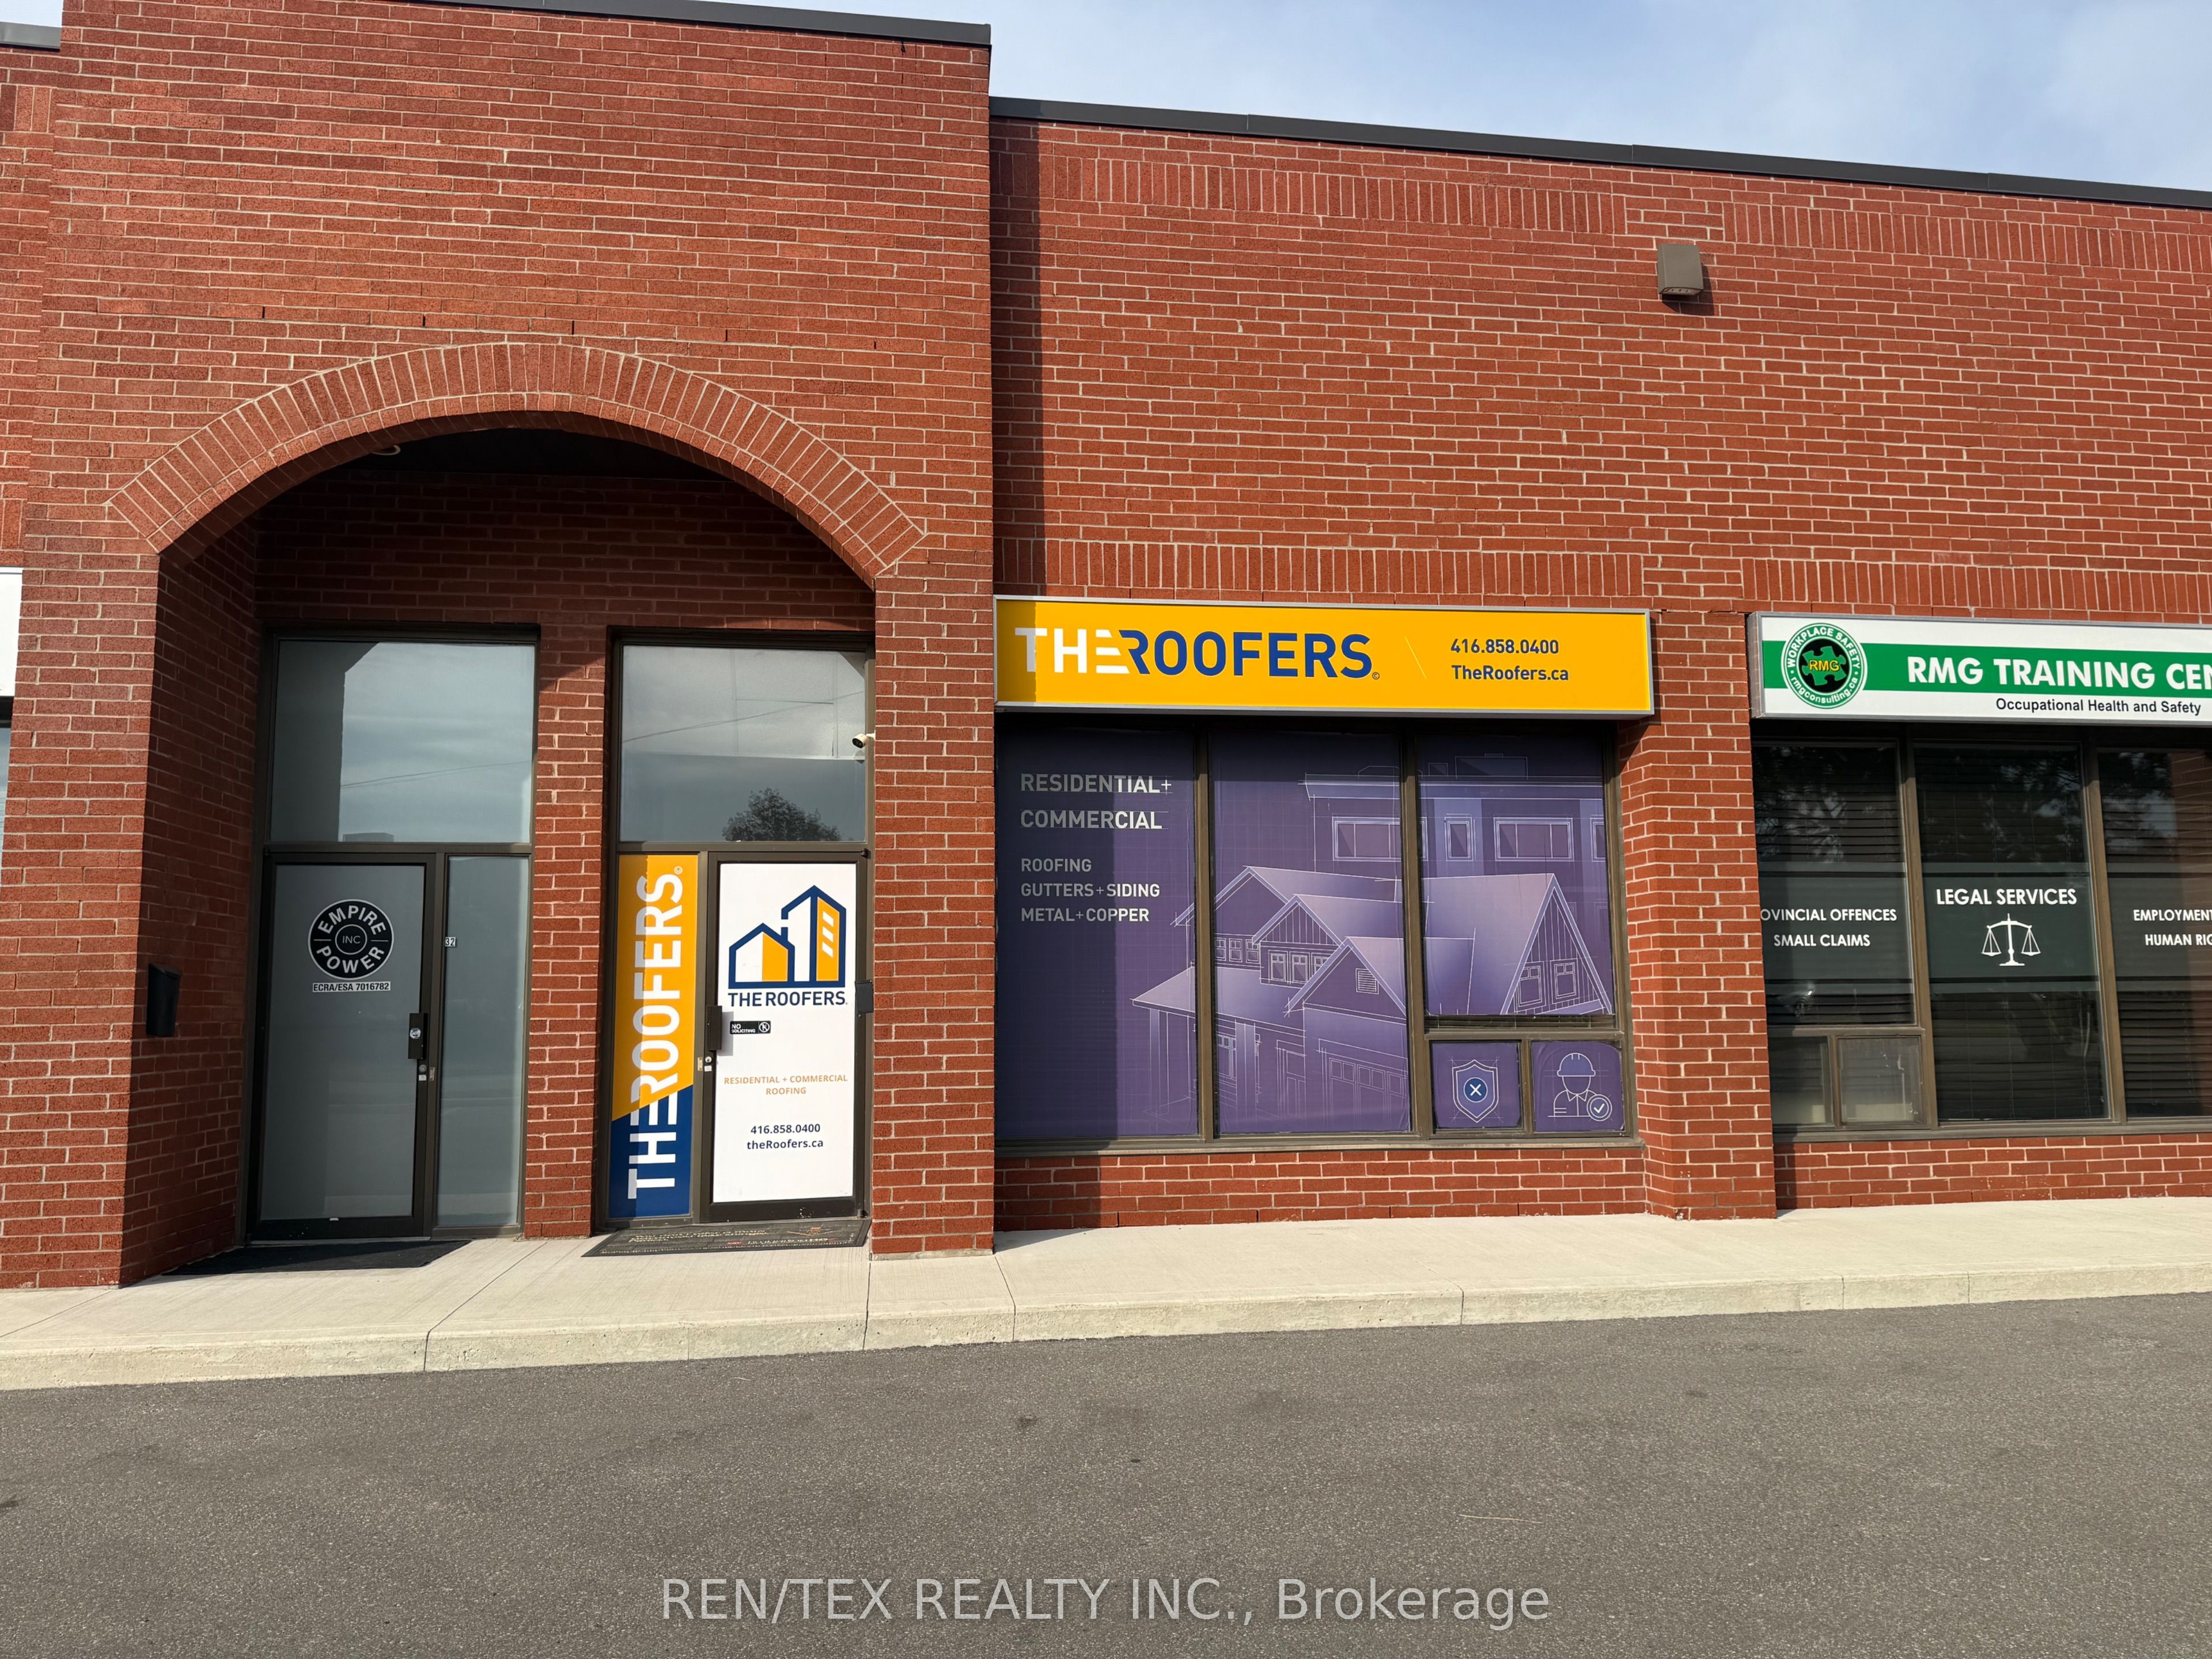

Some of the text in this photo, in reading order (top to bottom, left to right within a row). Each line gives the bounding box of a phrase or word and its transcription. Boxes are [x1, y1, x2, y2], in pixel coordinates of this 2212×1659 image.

[1450, 639, 1559, 654] 416.858.0400
[1787, 627, 1861, 669] WORKPLACE SAFETY
[1452, 664, 1569, 681] TheRoofers.ca
[1809, 660, 1840, 672] RMG
[1907, 656, 1983, 685] RMG
[1993, 658, 2156, 689] TRAINING
[1790, 677, 1858, 704] rmgconsulting.ca
[1996, 698, 2201, 715] Occupational Health and Safety
[1020, 809, 1162, 829] COMMERCIAL
[1021, 858, 1092, 872] ROOFING
[1936, 888, 2077, 906] LEGAL SERVICES
[317, 905, 387, 935] EMPIRE
[1830, 908, 1897, 922] OFFENCES
[342, 935, 361, 944] INC
[445, 937, 455, 946] 32
[1774, 934, 1871, 946] SMALL CLAIMS
[2145, 934, 2192, 946] HUMAN
[316, 945, 385, 974] POWER
[313, 982, 389, 991] ECRA/ESA 7016782
[724, 1076, 780, 1085] RESIDENTIAL
[790, 1075, 848, 1083] COMMERCIAL
[766, 1087, 806, 1095] ROOFING
[751, 1124, 821, 1134] 416.858.0400
[747, 1139, 824, 1149] theRoofers.ca
